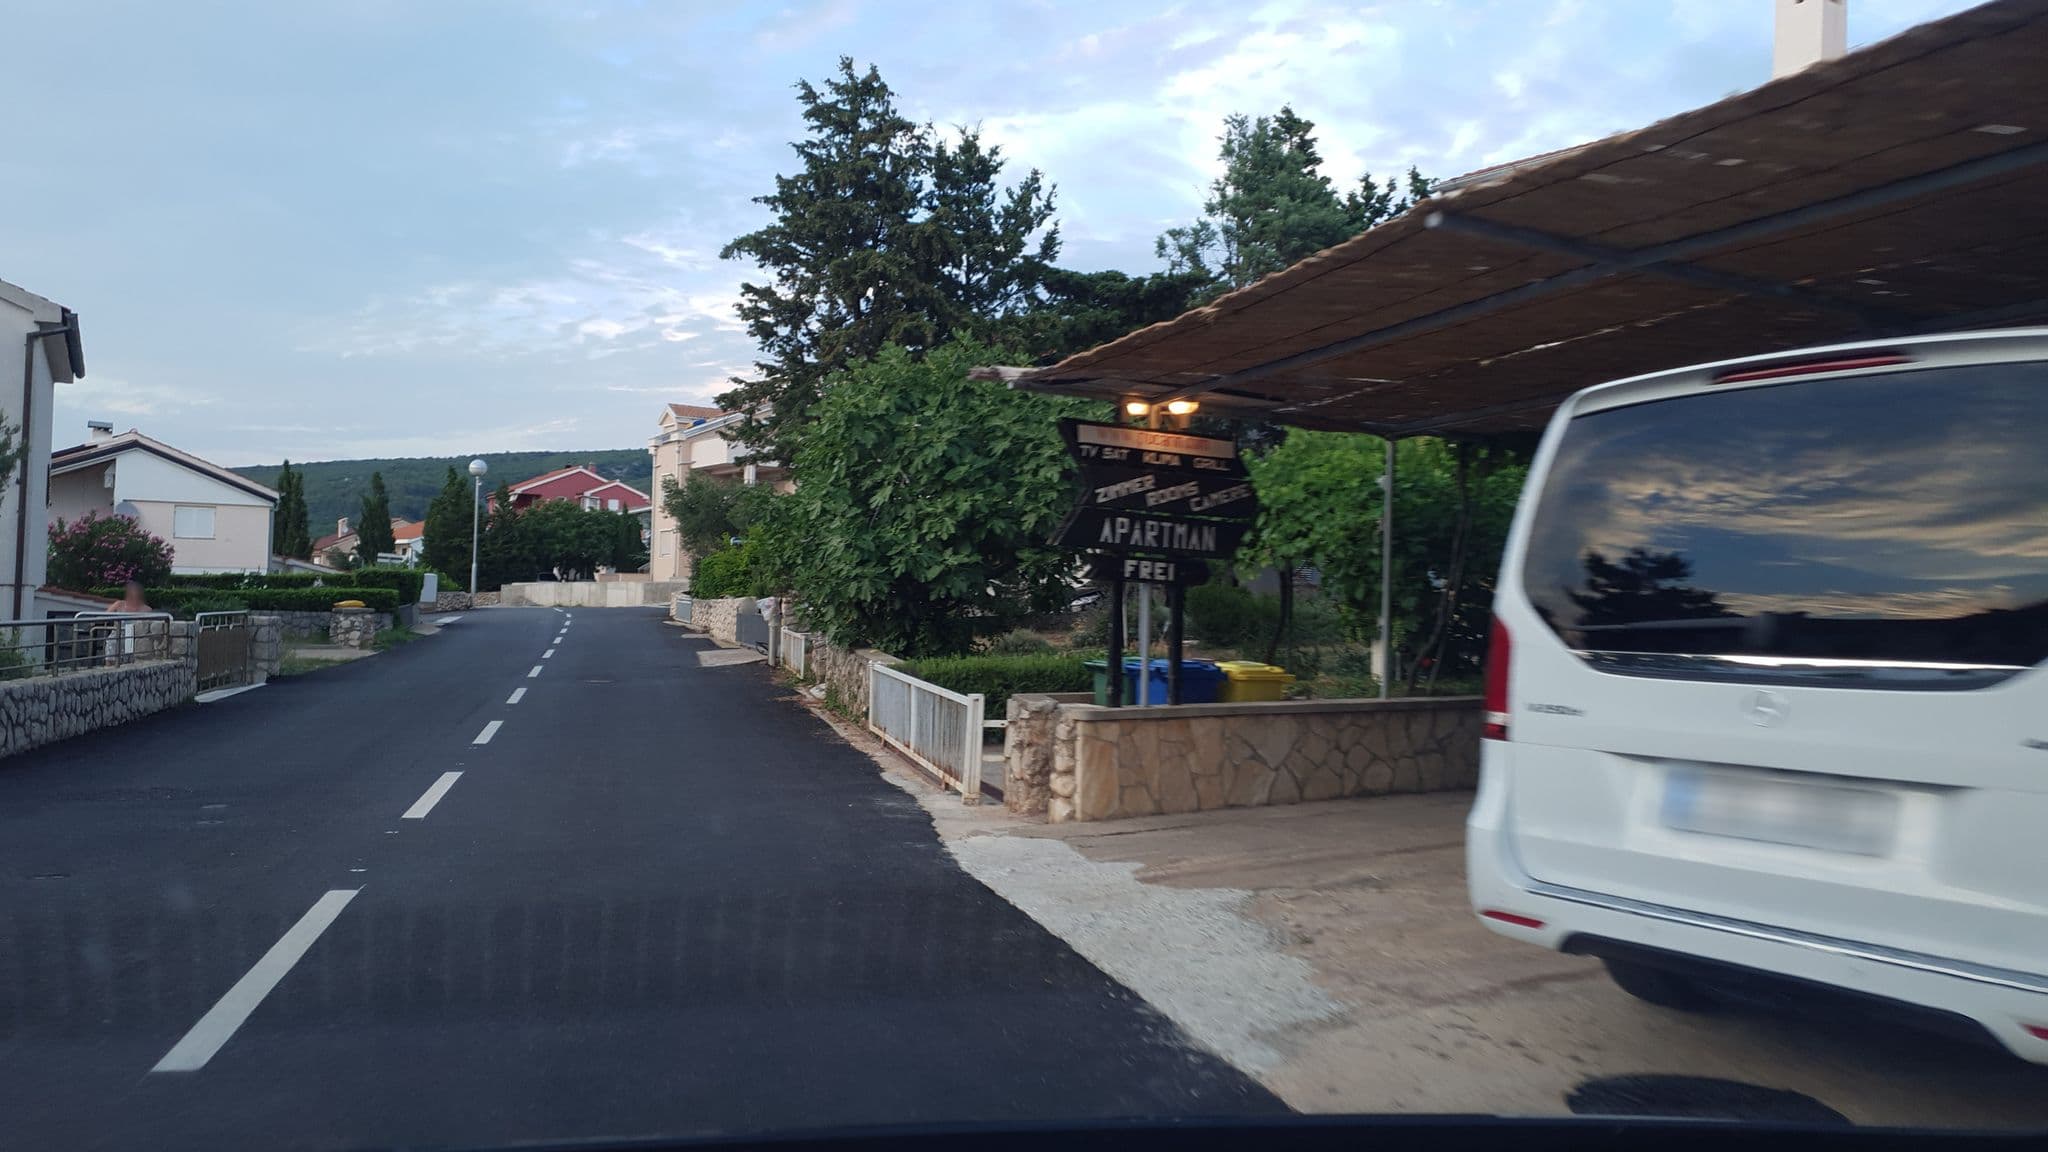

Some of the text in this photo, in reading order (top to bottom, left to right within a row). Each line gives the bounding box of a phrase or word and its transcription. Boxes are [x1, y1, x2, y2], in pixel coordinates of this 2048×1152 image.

[1079, 444, 1099, 457] TV
[1095, 474, 1156, 504] ZIMMER
[1100, 516, 1217, 551] APARTMAN
[1124, 559, 1176, 581] FREI
